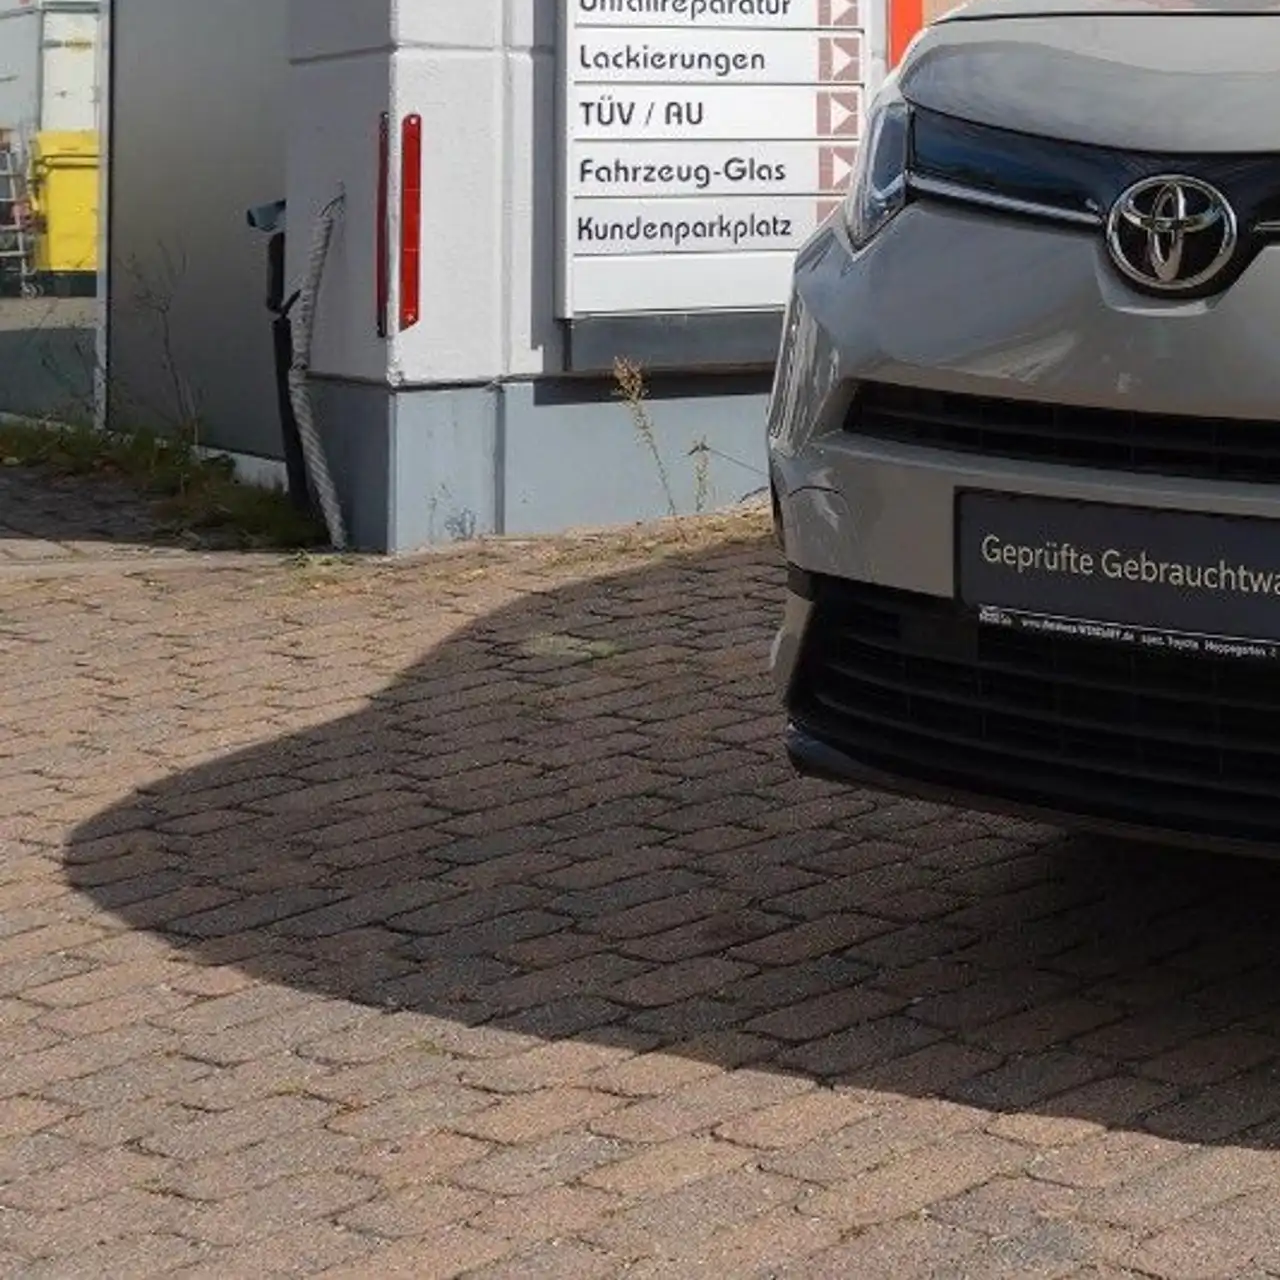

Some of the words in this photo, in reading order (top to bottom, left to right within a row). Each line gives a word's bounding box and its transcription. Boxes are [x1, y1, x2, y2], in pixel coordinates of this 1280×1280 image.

[580, 44, 766, 77] Lackierungen
[579, 94, 636, 126] TÜV
[664, 101, 704, 126] AU
[579, 156, 787, 189] Fahrzeug-Glas
[577, 213, 793, 246] Kundenparkplatz
[980, 534, 1095, 576] Geprüfte
